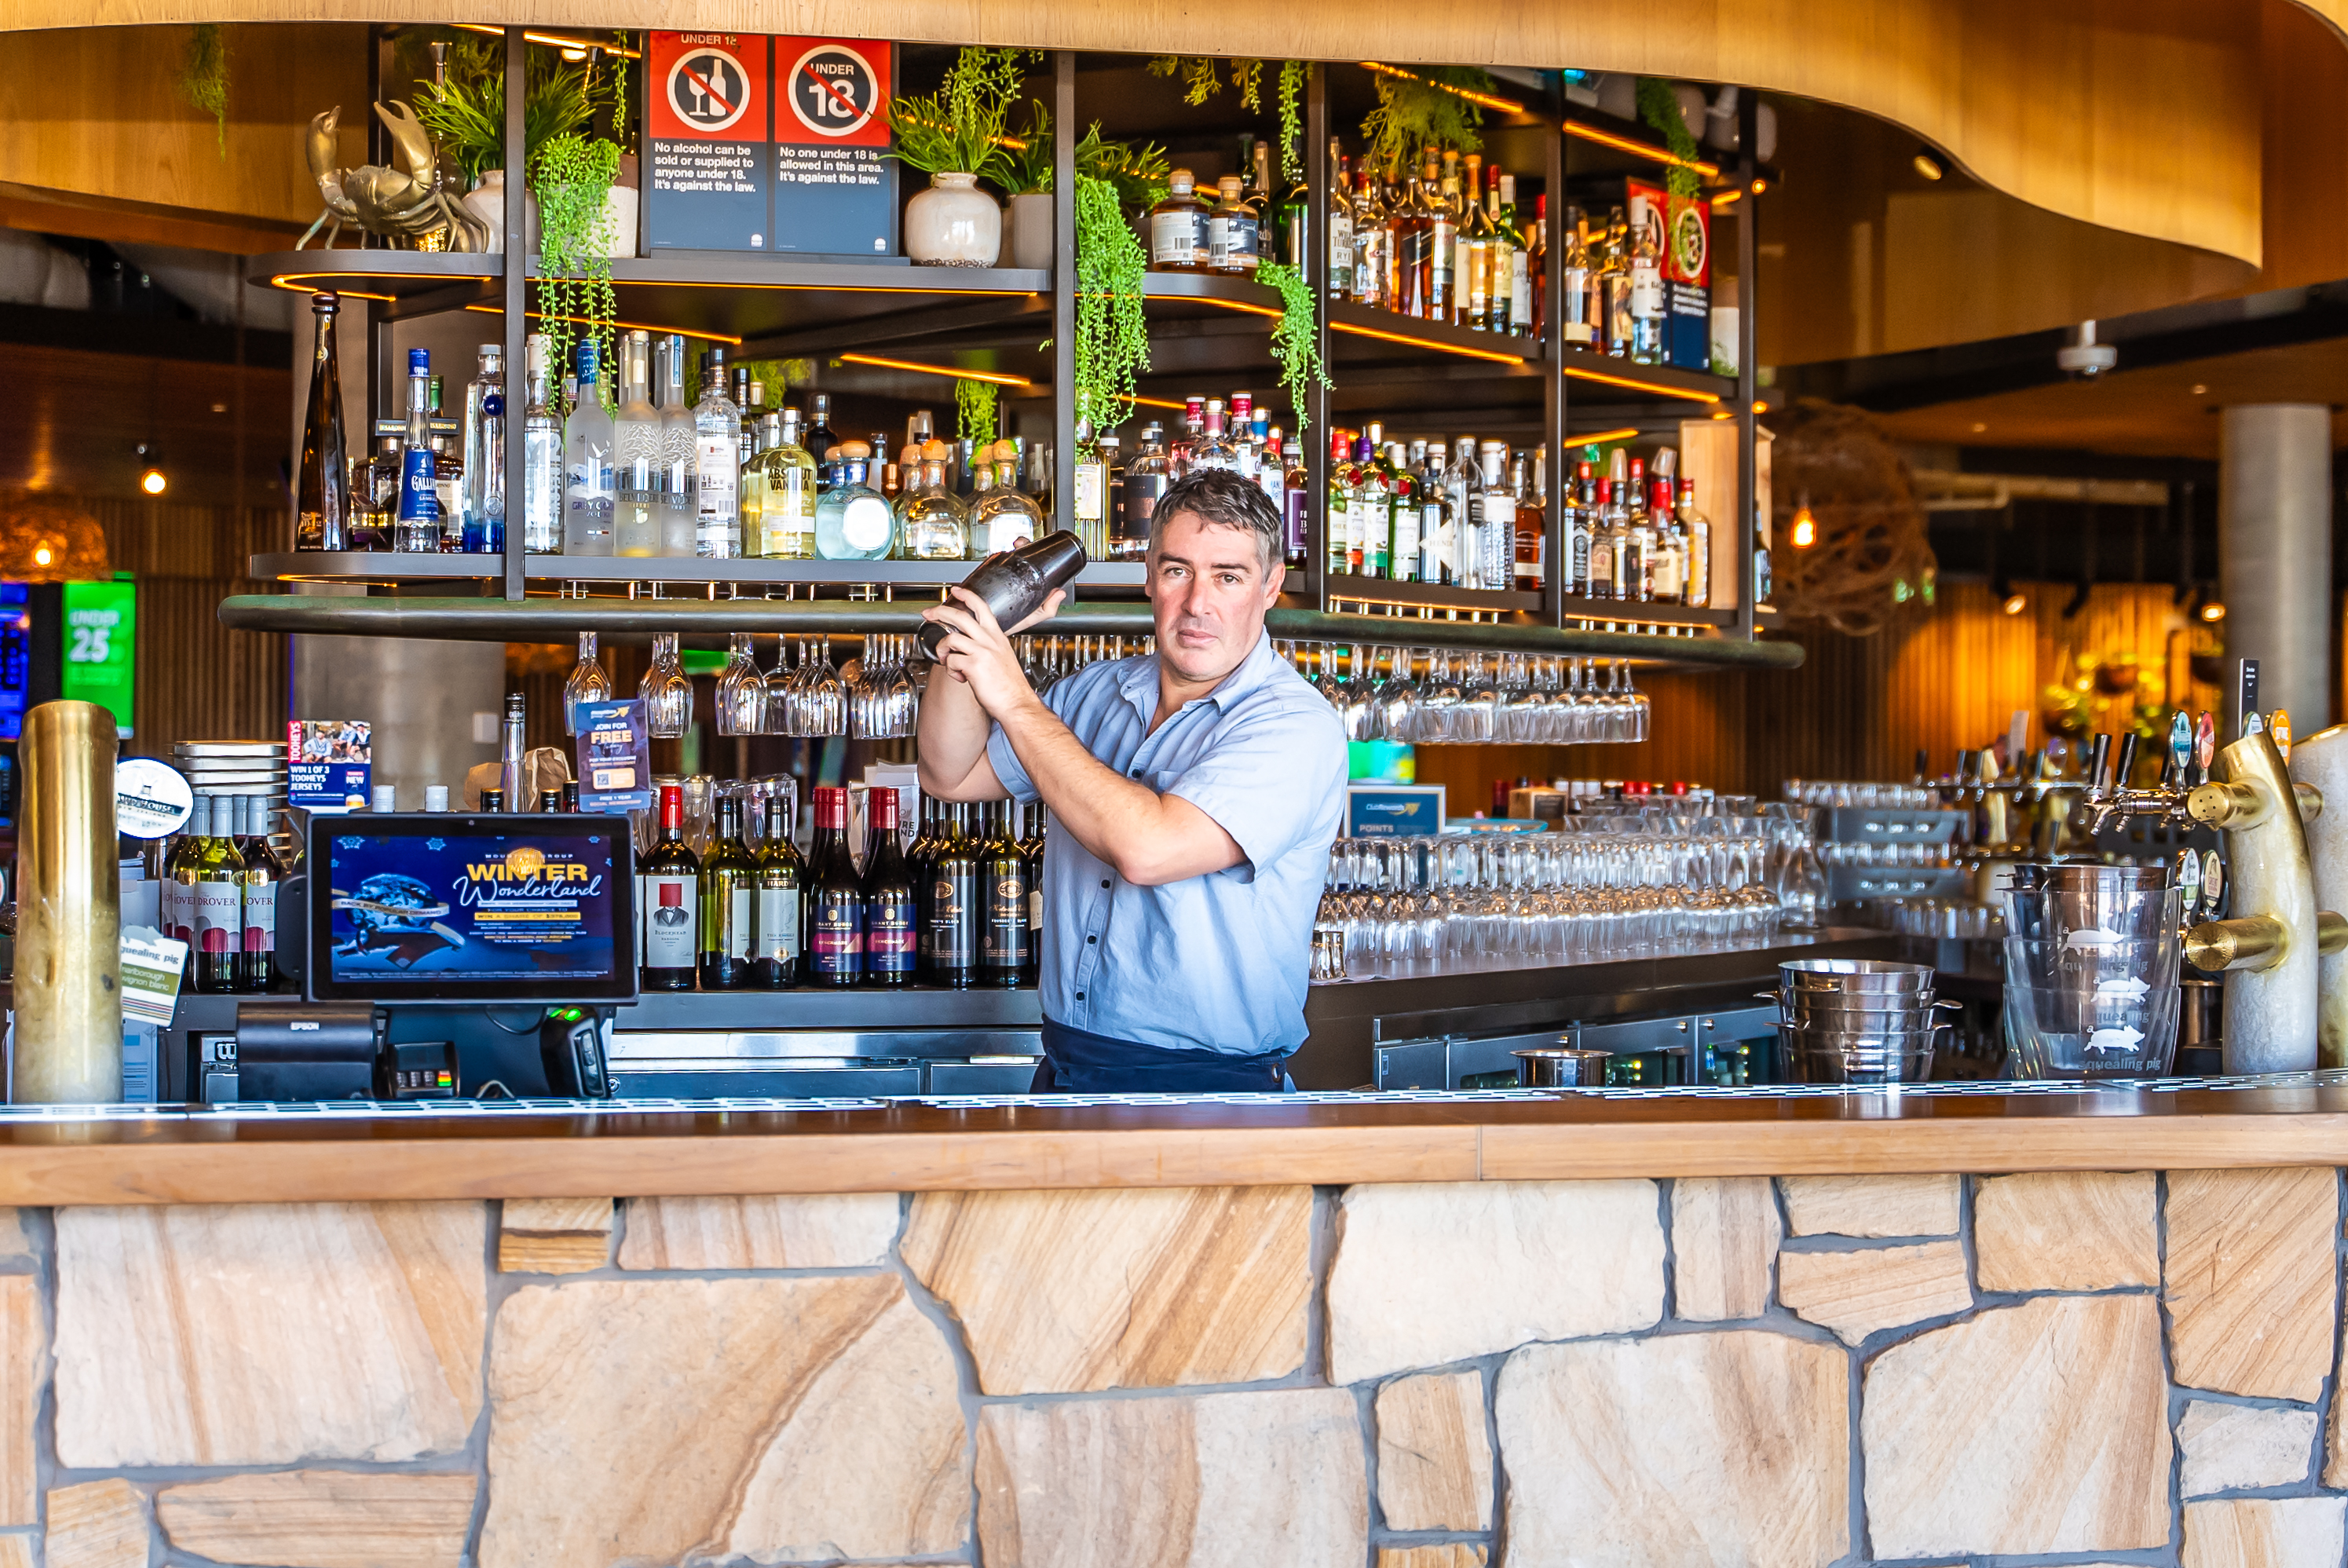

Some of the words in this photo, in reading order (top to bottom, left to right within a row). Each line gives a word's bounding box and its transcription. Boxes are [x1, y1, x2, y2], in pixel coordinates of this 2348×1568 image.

[681, 34, 722, 45] UNDER
[810, 63, 854, 75] UNDER
[809, 79, 856, 119] 18
[655, 143, 671, 153] No
[673, 143, 712, 155] alcohol
[715, 146, 736, 155] can
[737, 144, 752, 156] be
[780, 147, 795, 157] No
[799, 149, 818, 159] one
[821, 149, 852, 160] under
[854, 150, 867, 160] 18
[869, 151, 878, 160] is
[655, 155, 678, 166] sold
[680, 156, 693, 166] or
[694, 155, 741, 170] supplied
[742, 158, 755, 168] to
[780, 159, 821, 171] allowed
[824, 160, 834, 171] in
[836, 161, 856, 173] this
[858, 163, 884, 174] area.
[655, 169, 695, 181] anyone
[697, 169, 729, 181] under
[731, 170, 747, 180] 18.
[780, 171, 796, 182] It's
[798, 171, 837, 185] against
[839, 173, 857, 184] the
[858, 174, 880, 185] law.
[655, 181, 671, 190] It's
[673, 181, 713, 193] against
[715, 181, 733, 192] the
[734, 182, 756, 193] law.
[69, 628, 111, 663] 25
[291, 722, 302, 762] TOOHEYS
[591, 730, 632, 744] FREE
[291, 766, 307, 774] WIN
[308, 766, 312, 774] 1
[313, 766, 324, 774] OF
[324, 766, 330, 774] 3
[291, 774, 327, 783] TOOHEYS
[346, 776, 364, 784] NEW
[1359, 824, 1394, 833] POINTS
[466, 864, 588, 881] WINTER
[452, 875, 602, 906] Wonderland
[198, 897, 236, 906] DROVER
[163, 954, 179, 965] pig
[149, 980, 170, 992] blanc
[290, 1022, 320, 1031] EPSON
[2078, 1058, 2143, 1072] squealing
[2145, 1056, 2162, 1071] pig
